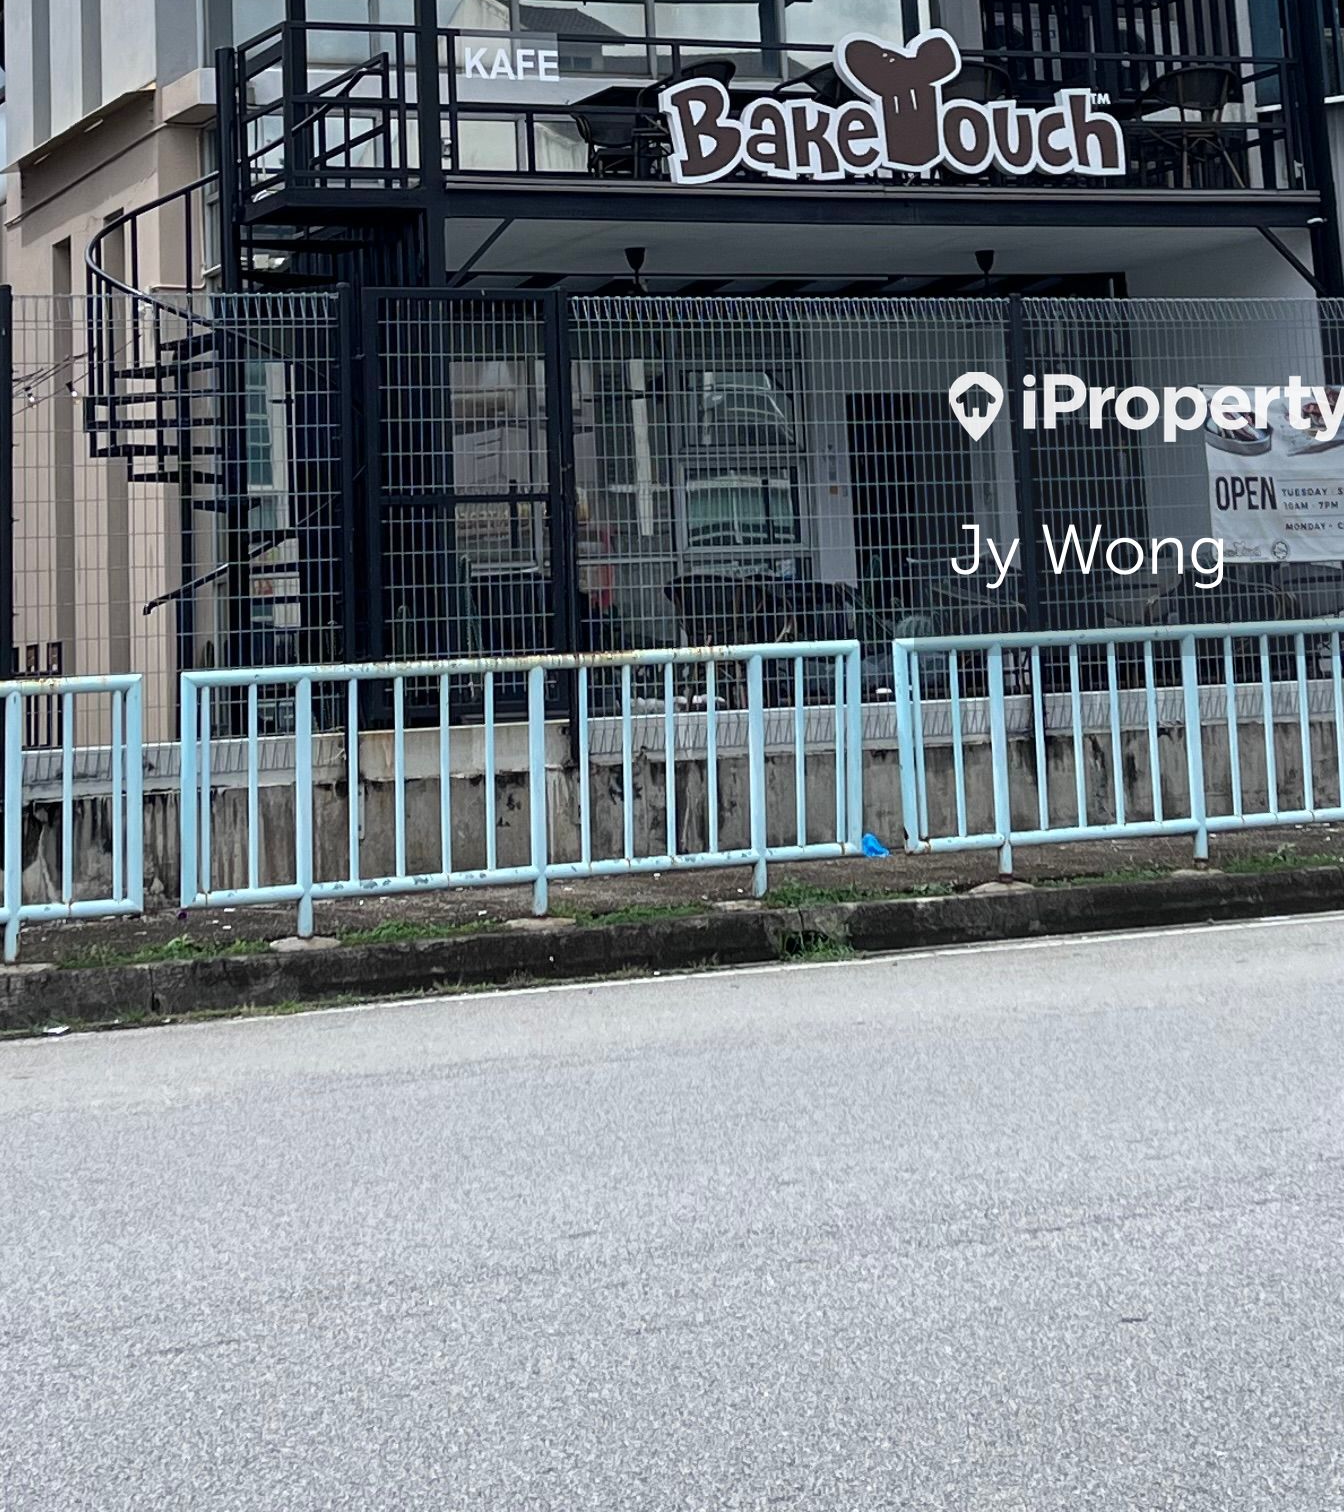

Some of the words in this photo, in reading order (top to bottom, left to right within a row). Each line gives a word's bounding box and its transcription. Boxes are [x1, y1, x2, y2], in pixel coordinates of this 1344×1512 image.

[463, 46, 560, 82] KAFE
[1215, 476, 1278, 511] OPEN
[1282, 488, 1328, 497] TUESDAY
[1284, 501, 1309, 510] 10AM
[1318, 501, 1339, 510] 7PM
[1285, 522, 1326, 531] MONDAY
